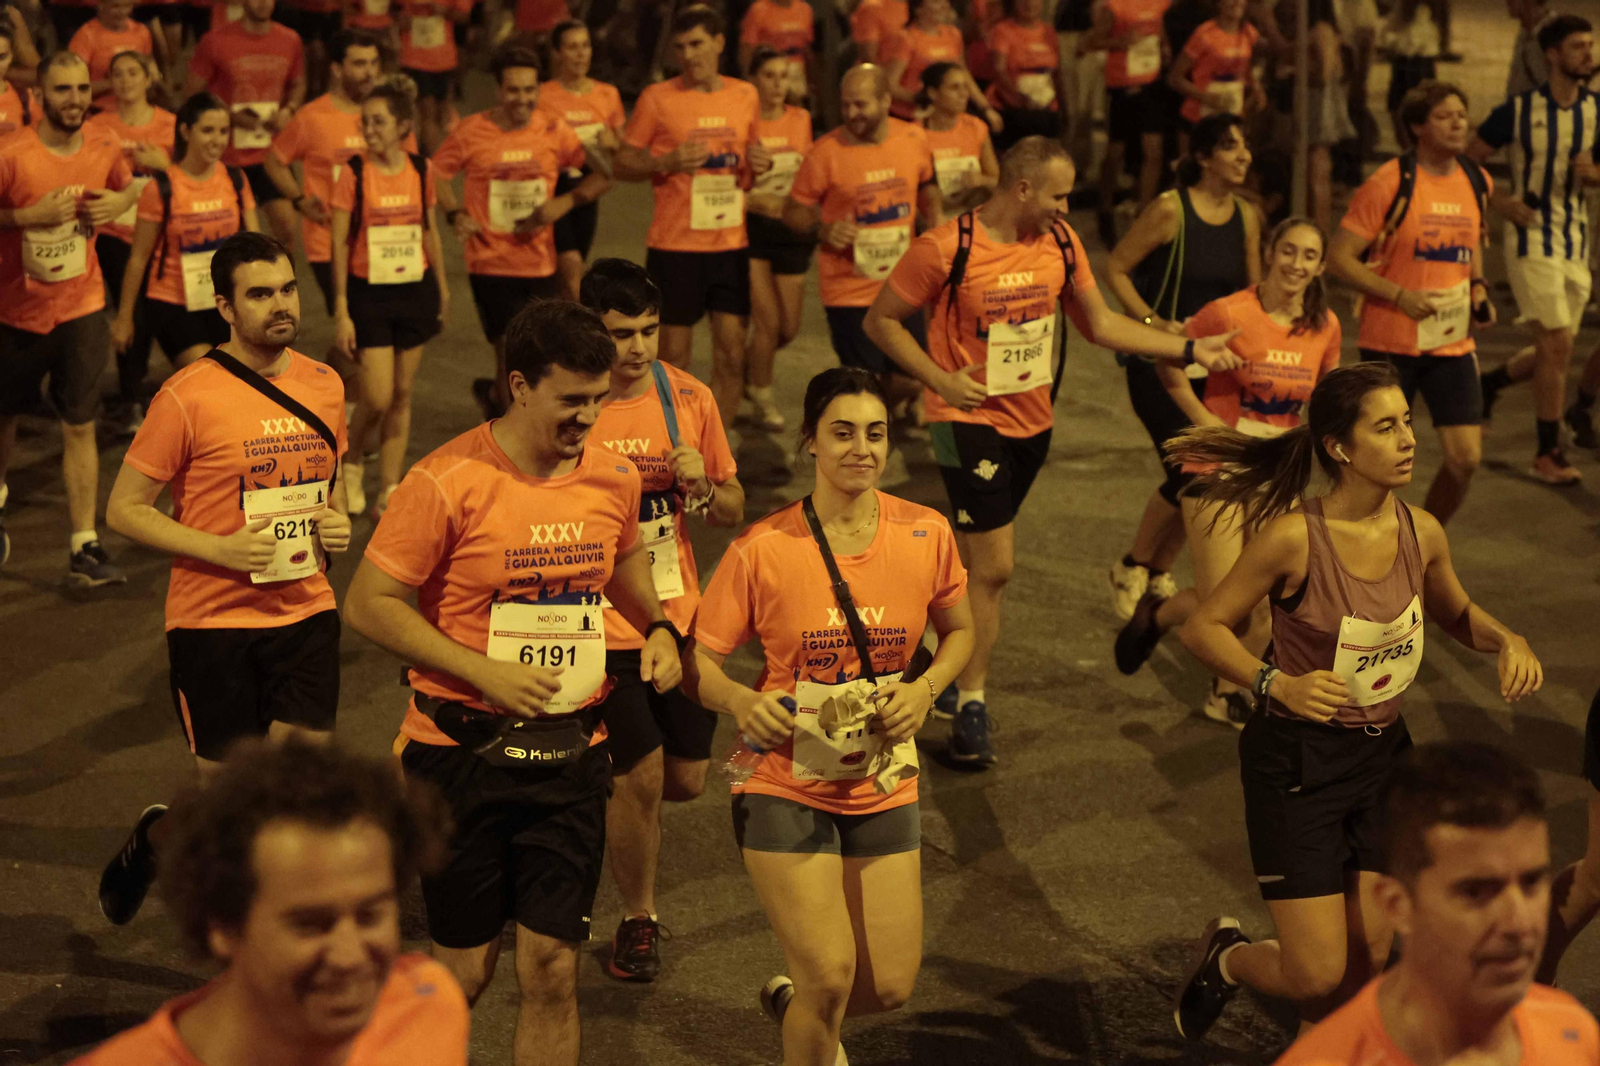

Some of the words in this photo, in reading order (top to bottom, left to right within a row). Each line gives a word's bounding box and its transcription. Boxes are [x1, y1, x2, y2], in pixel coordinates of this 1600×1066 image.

[36, 241, 76, 258] 22295
[998, 271, 1033, 287] XXXV
[243, 437, 281, 447] CARRERA
[284, 432, 324, 442] NOCTURN
[251, 442, 326, 456] GUADALQUIVIR
[530, 521, 584, 544] XXXV
[505, 547, 550, 557] CARRERA
[554, 542, 604, 553] NOCTURNA
[512, 552, 605, 569] GUADALQUIVIR
[802, 629, 848, 639] CARRERA
[519, 644, 576, 666] 6191
[1355, 638, 1414, 674] 21735
